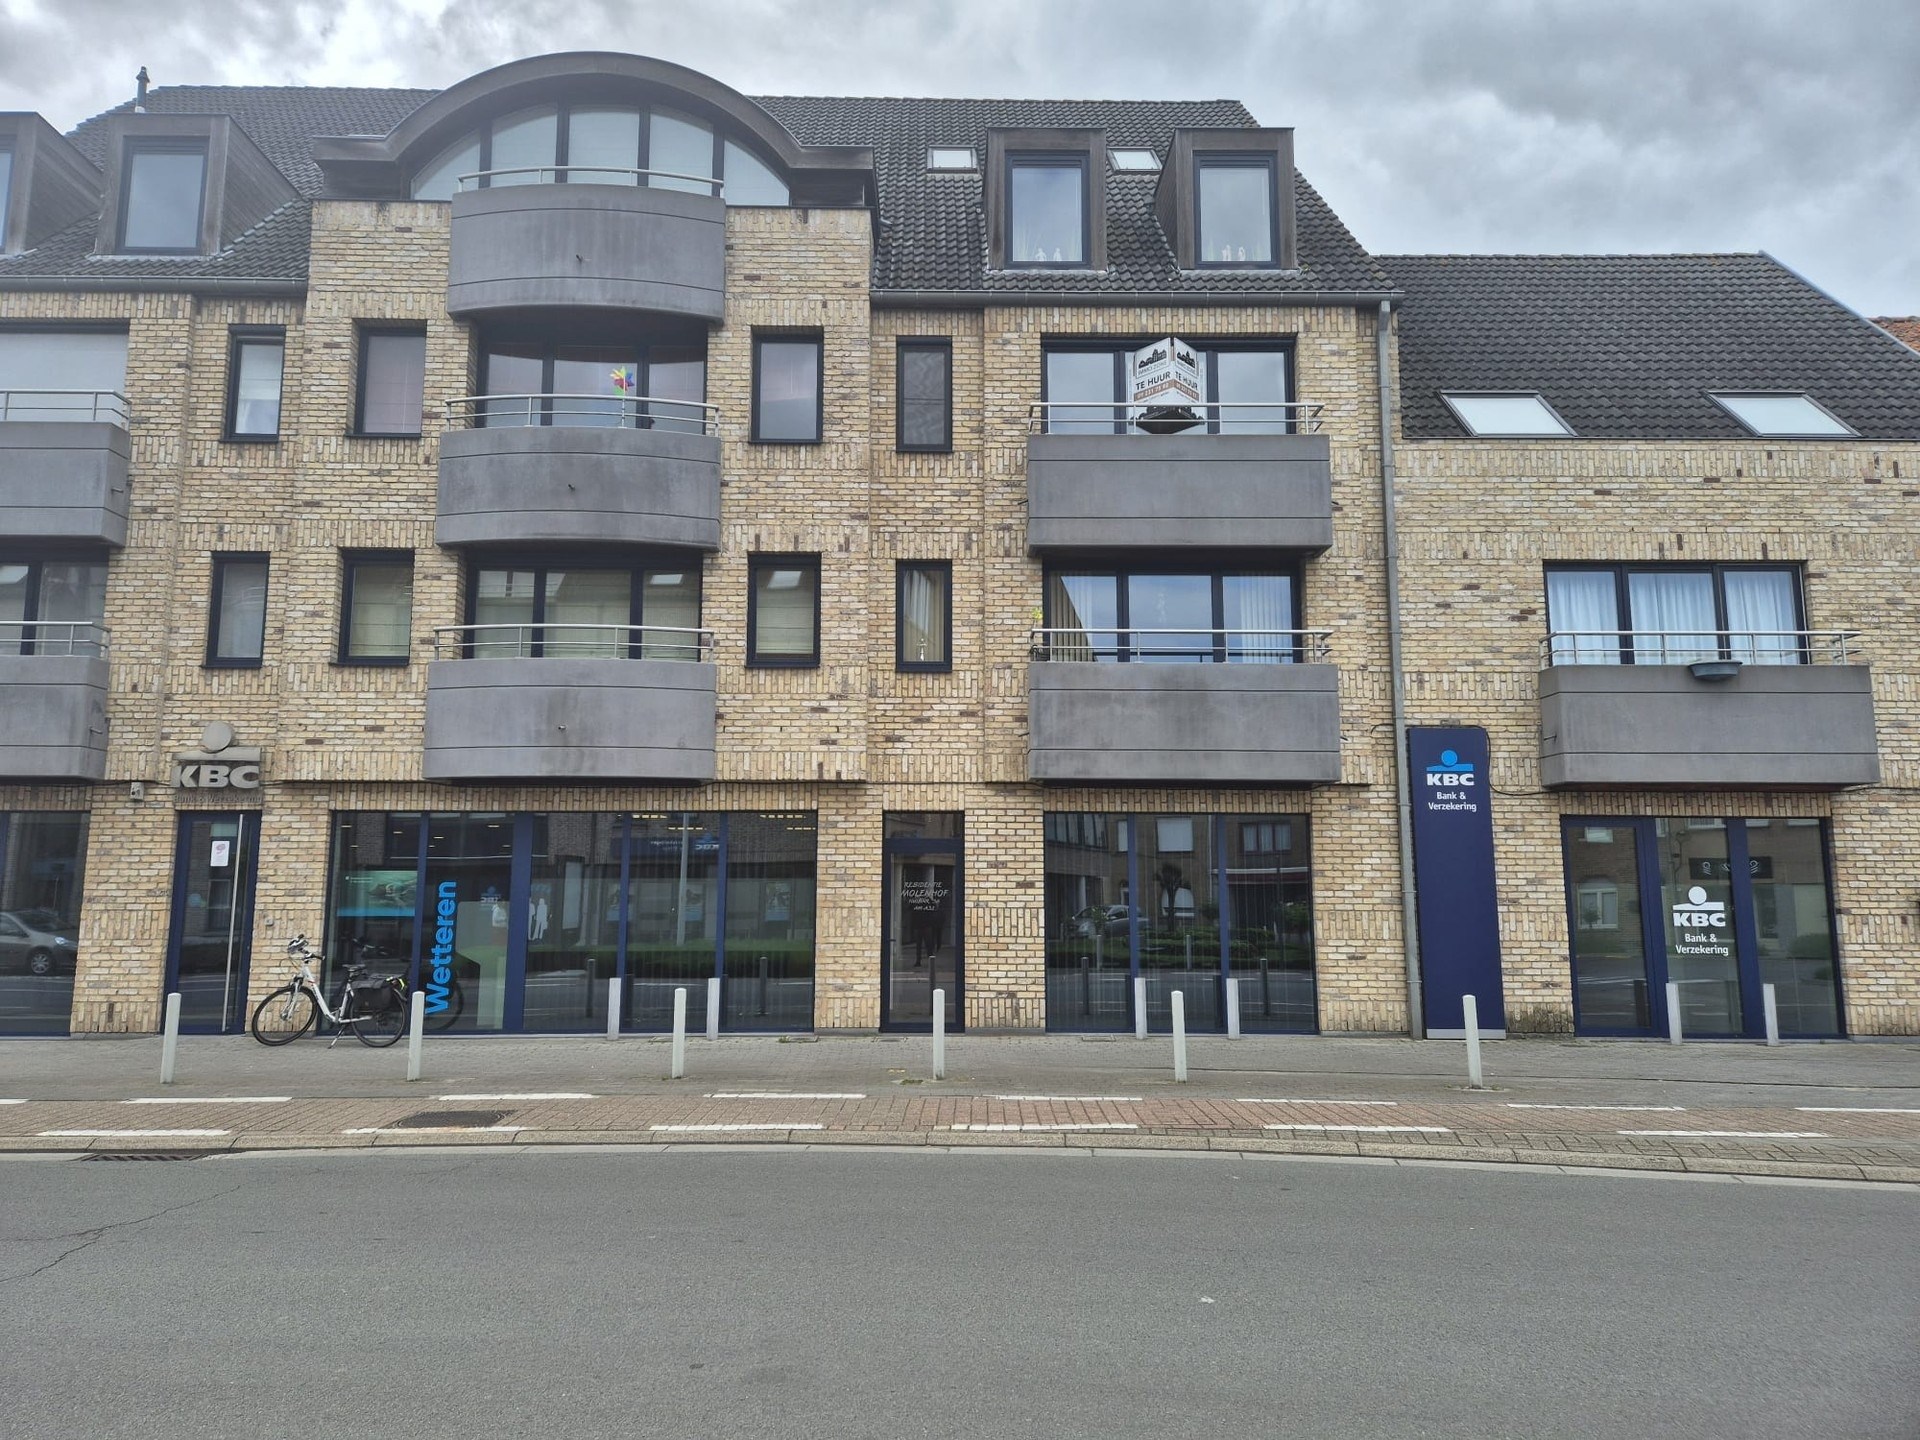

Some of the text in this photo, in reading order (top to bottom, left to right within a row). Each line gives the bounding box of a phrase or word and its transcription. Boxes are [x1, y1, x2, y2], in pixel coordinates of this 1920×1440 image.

[1135, 371, 1171, 391] TE HUUR
[1174, 371, 1182, 381] TE
[1182, 376, 1198, 391] HUUR
[170, 764, 260, 789] KBC
[1426, 773, 1475, 786] KBC
[1436, 791, 1467, 800] Bank &
[1428, 801, 1477, 812] Verzekering
[900, 889, 950, 898] MOLENHOF
[1672, 912, 1726, 927] KBC
[1684, 933, 1717, 943] Bank &
[424, 880, 458, 1015] Wetteren
[1675, 944, 1729, 957] Verzekering
